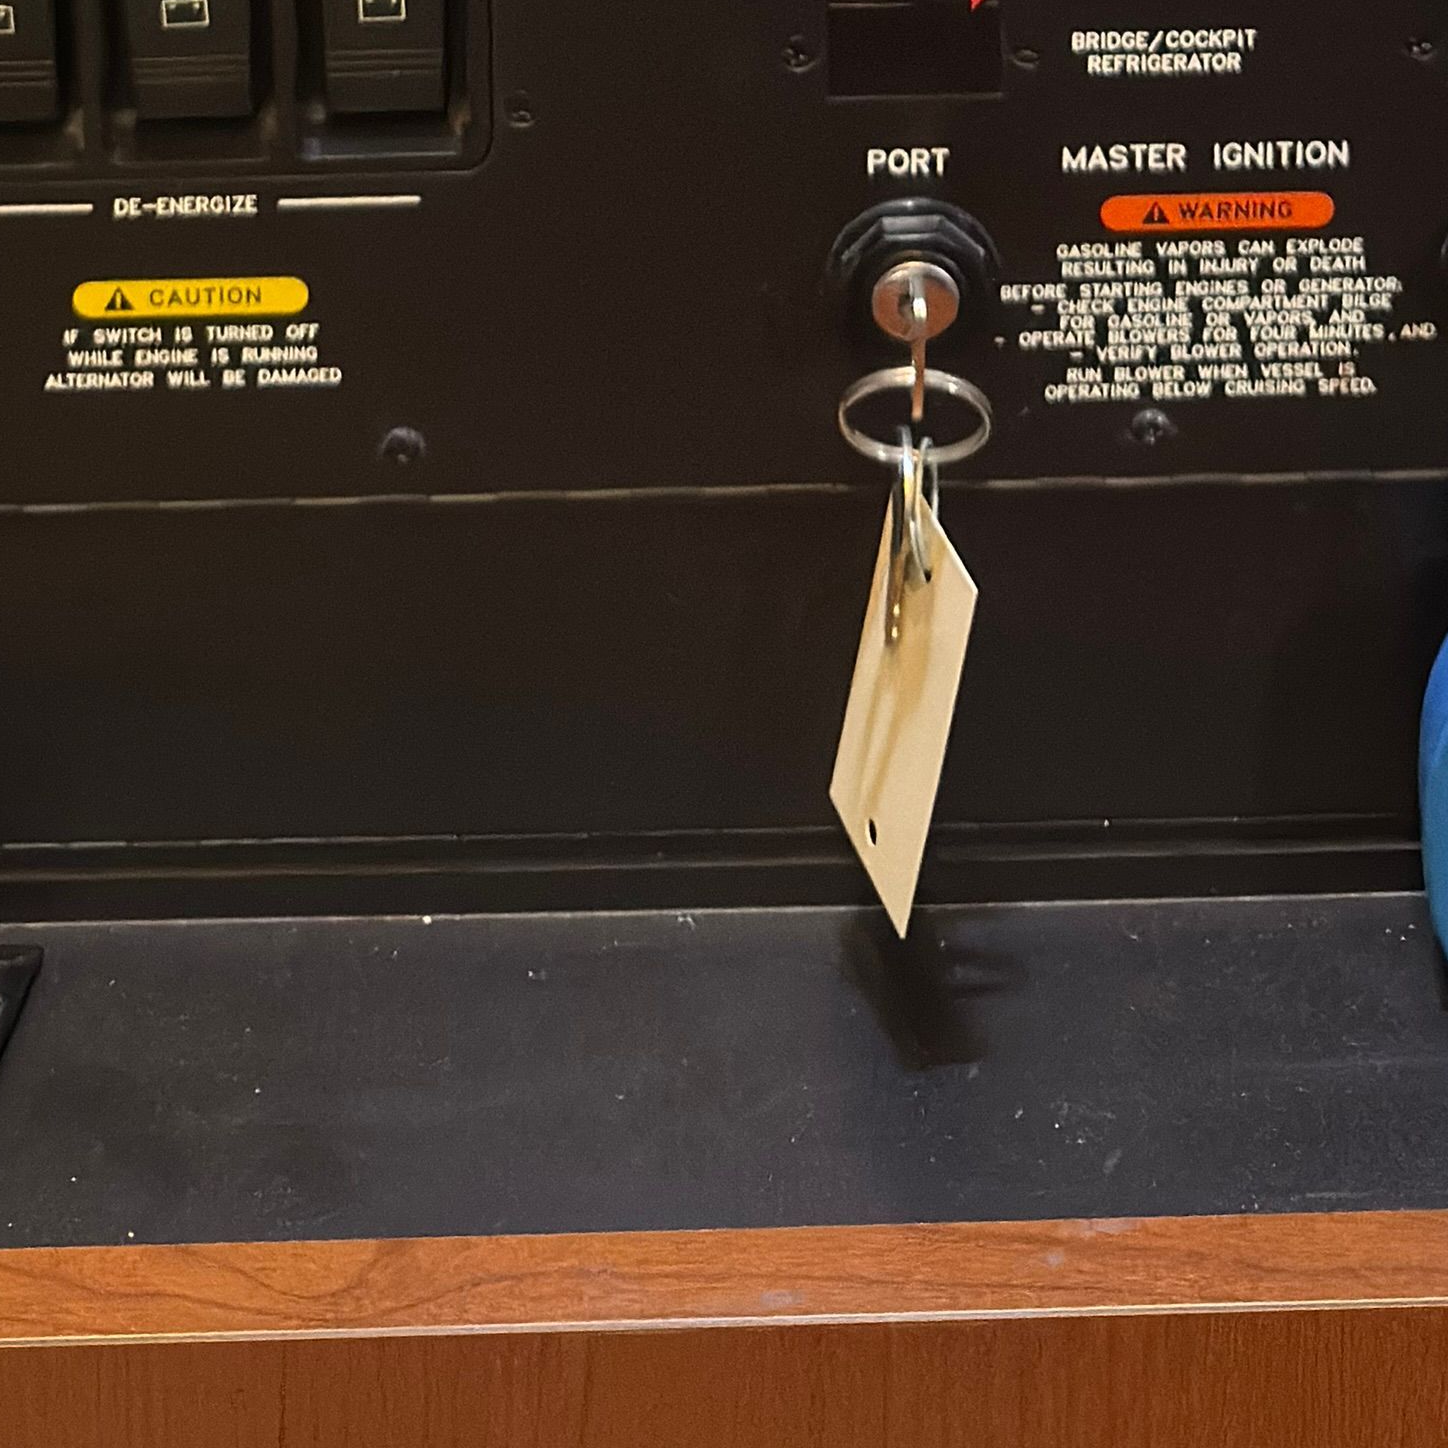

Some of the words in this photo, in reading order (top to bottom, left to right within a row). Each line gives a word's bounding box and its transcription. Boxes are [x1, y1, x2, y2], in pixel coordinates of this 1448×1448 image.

[1072, 29, 1256, 52] BRIDGE/COCKPIT
[1088, 53, 1240, 73] REFRIGERATOR
[868, 148, 949, 175] PORT
[1062, 143, 1186, 170] MASTER
[1214, 141, 1348, 168] IGNITION
[114, 195, 257, 216] DE-ENERGIZE
[1179, 200, 1292, 221] WARNING
[1057, 242, 1141, 259] GASOLINE
[1156, 241, 1225, 257] VAPORS
[1238, 240, 1274, 255] CAN
[1286, 237, 1363, 255] EXPLODE
[149, 286, 262, 307] CAUTION
